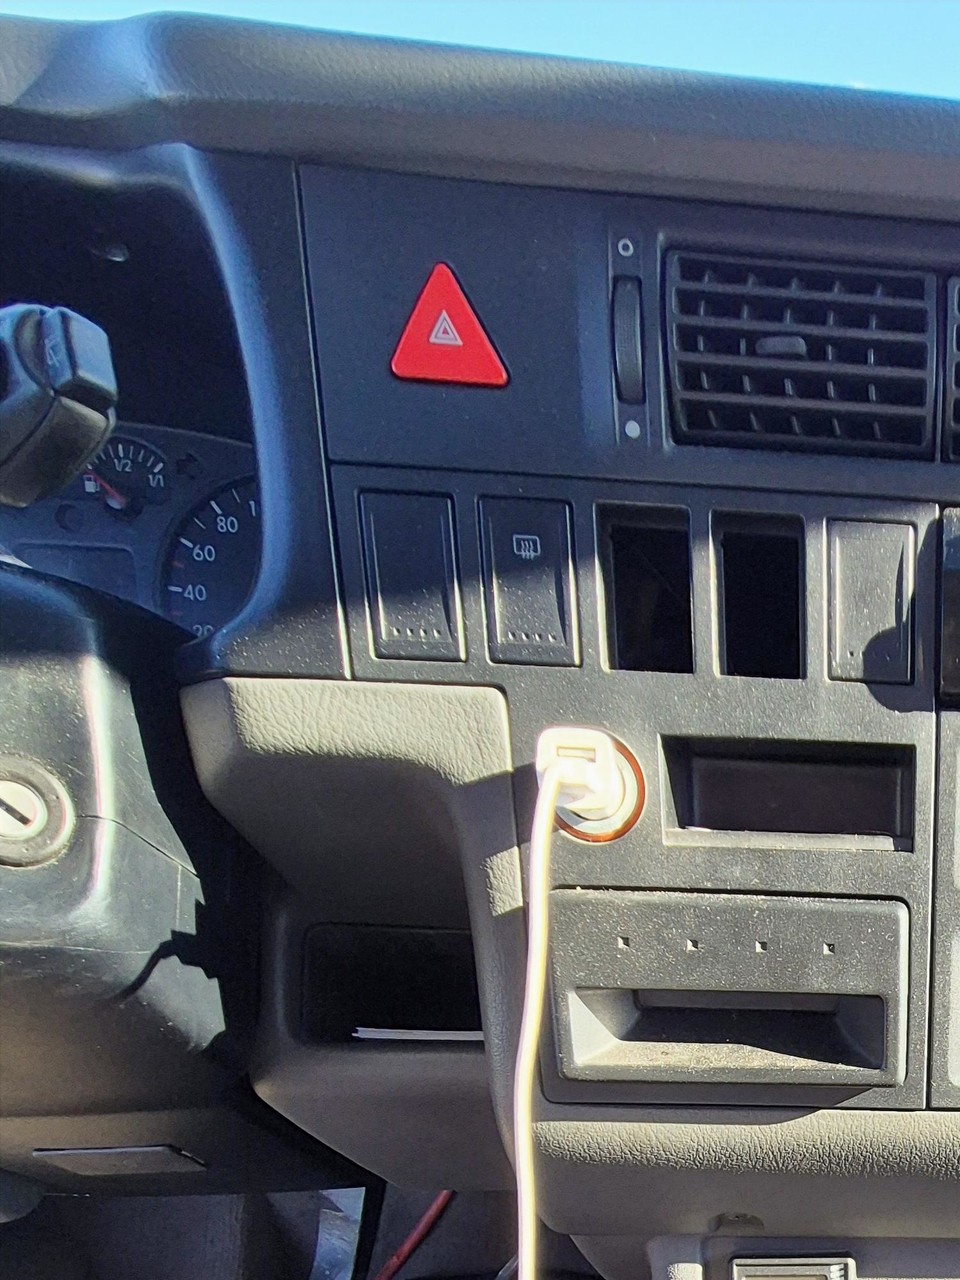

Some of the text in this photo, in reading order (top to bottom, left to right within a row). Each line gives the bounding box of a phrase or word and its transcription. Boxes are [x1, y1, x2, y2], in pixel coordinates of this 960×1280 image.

[216, 515, 239, 533] 80
[192, 544, 215, 561] 60
[183, 584, 207, 601] 40
